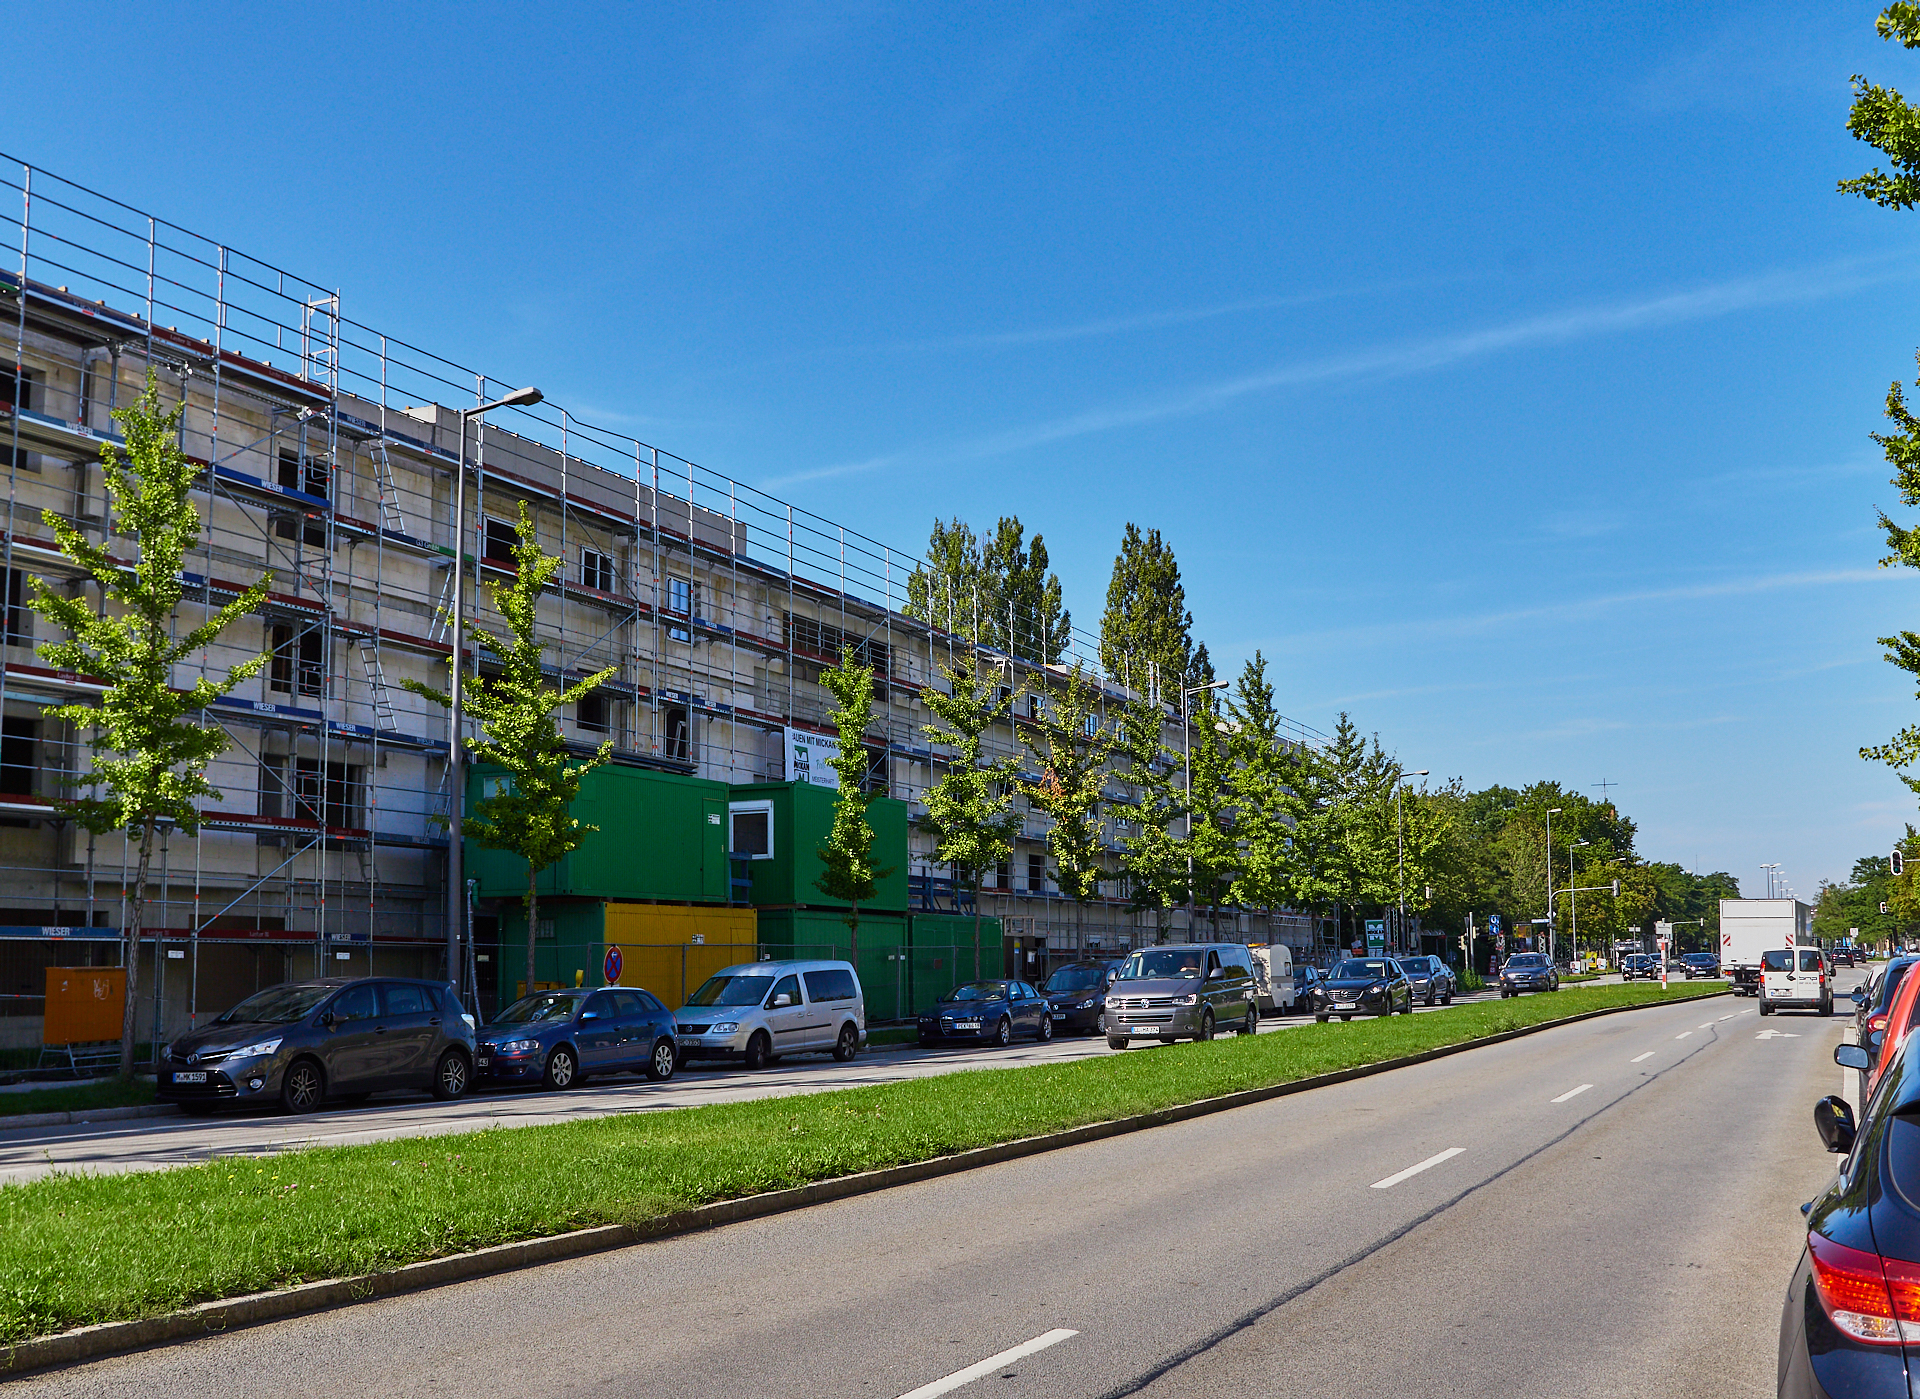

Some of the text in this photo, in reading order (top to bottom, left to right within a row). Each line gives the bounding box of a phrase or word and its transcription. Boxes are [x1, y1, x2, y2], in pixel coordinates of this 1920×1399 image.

[346, 414, 366, 427] WIESER
[65, 421, 94, 436] WIESER
[261, 479, 283, 493] WIESER
[253, 701, 276, 712] WIESER
[335, 722, 356, 732] WIESER
[806, 736, 815, 746] MIT
[42, 926, 71, 936] WIESER
[331, 933, 351, 941] WIESER
[191, 1072, 207, 1082] 1591
